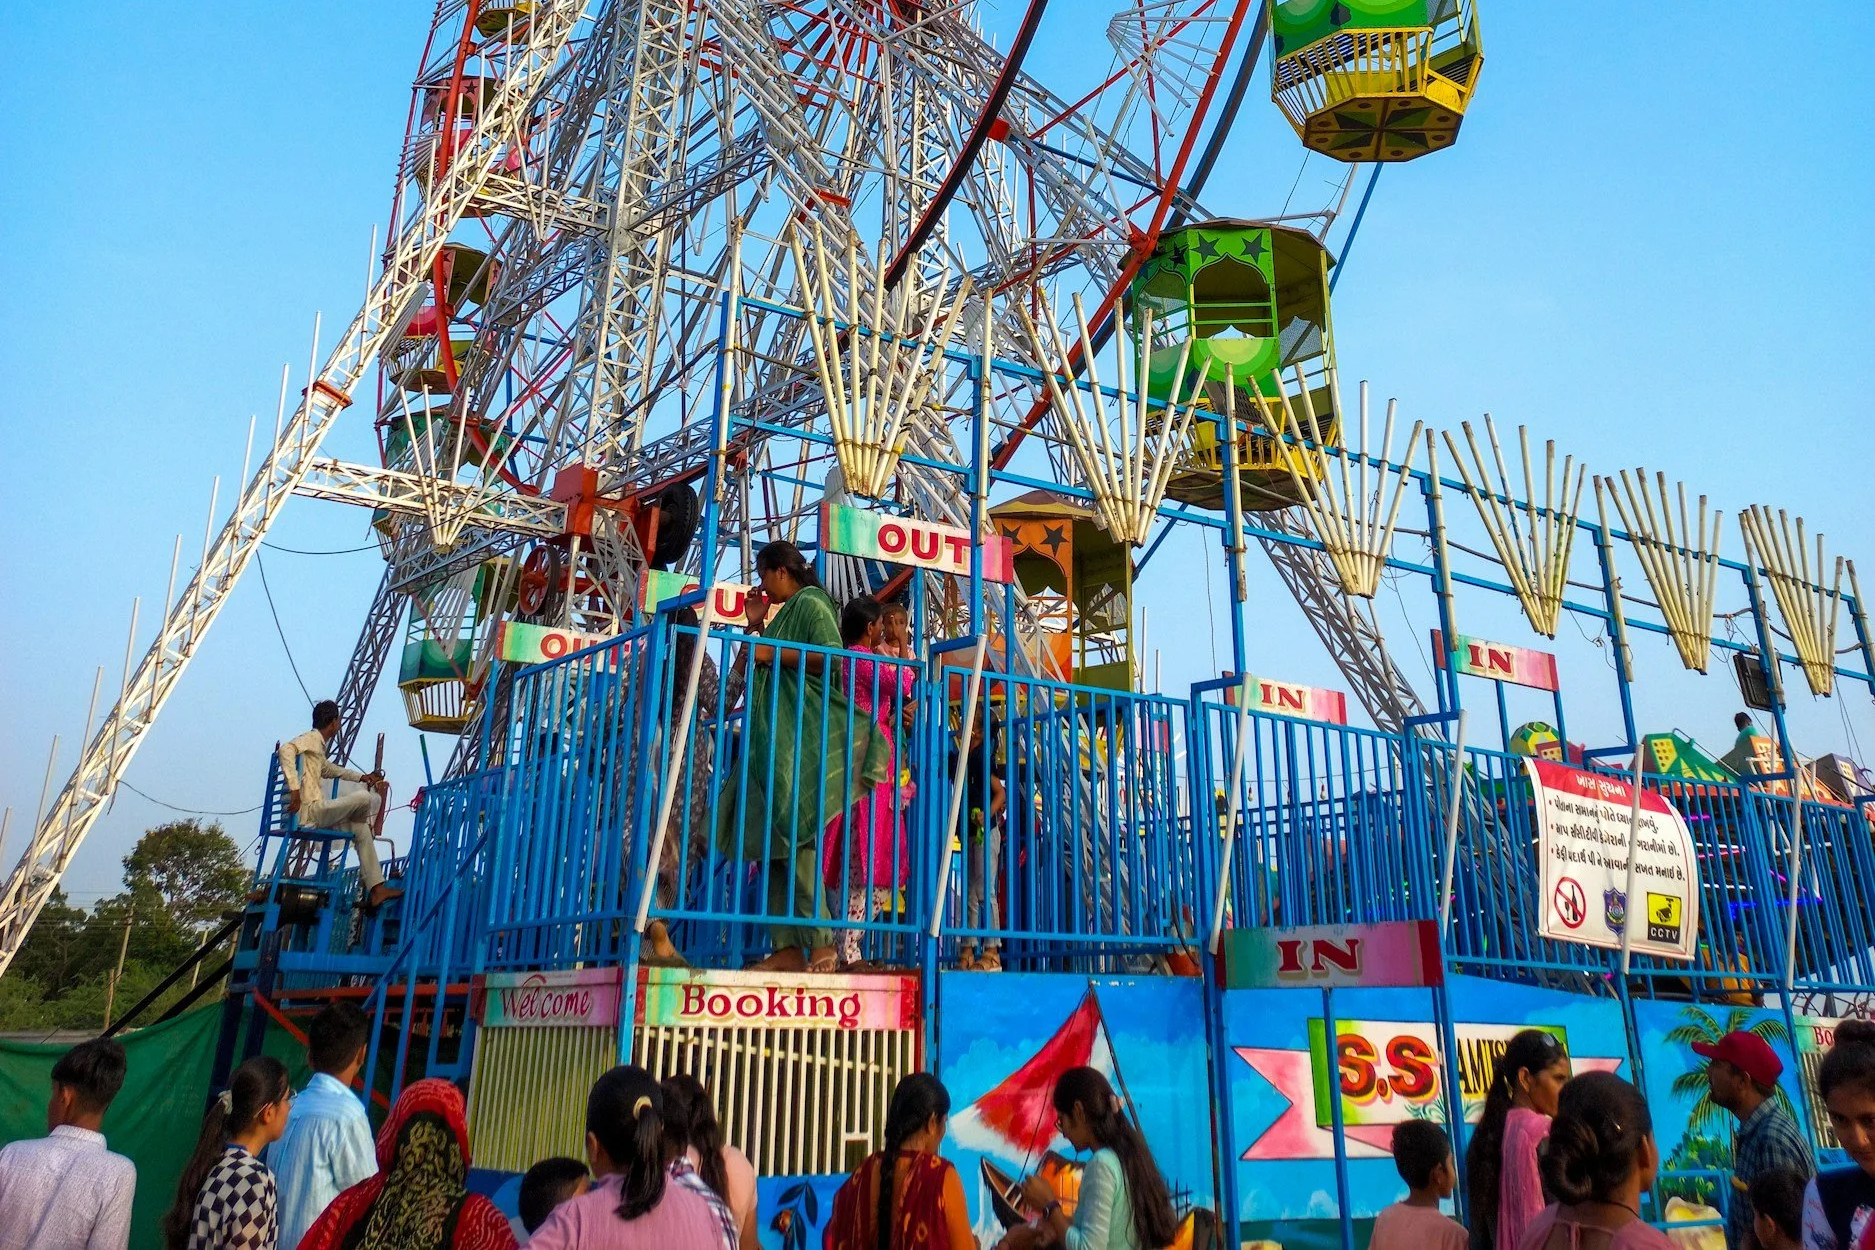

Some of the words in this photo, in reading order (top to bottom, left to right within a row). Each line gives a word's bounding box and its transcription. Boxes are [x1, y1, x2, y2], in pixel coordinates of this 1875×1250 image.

[878, 524, 971, 564] OUT
[1468, 645, 1513, 674] IN
[1260, 684, 1304, 709] IN
[1650, 927, 1678, 940] CCTV
[1277, 939, 1360, 972] IN
[501, 975, 591, 1019] Welcome
[681, 984, 861, 1028] Booking
[1337, 1034, 1434, 1098] S.S
